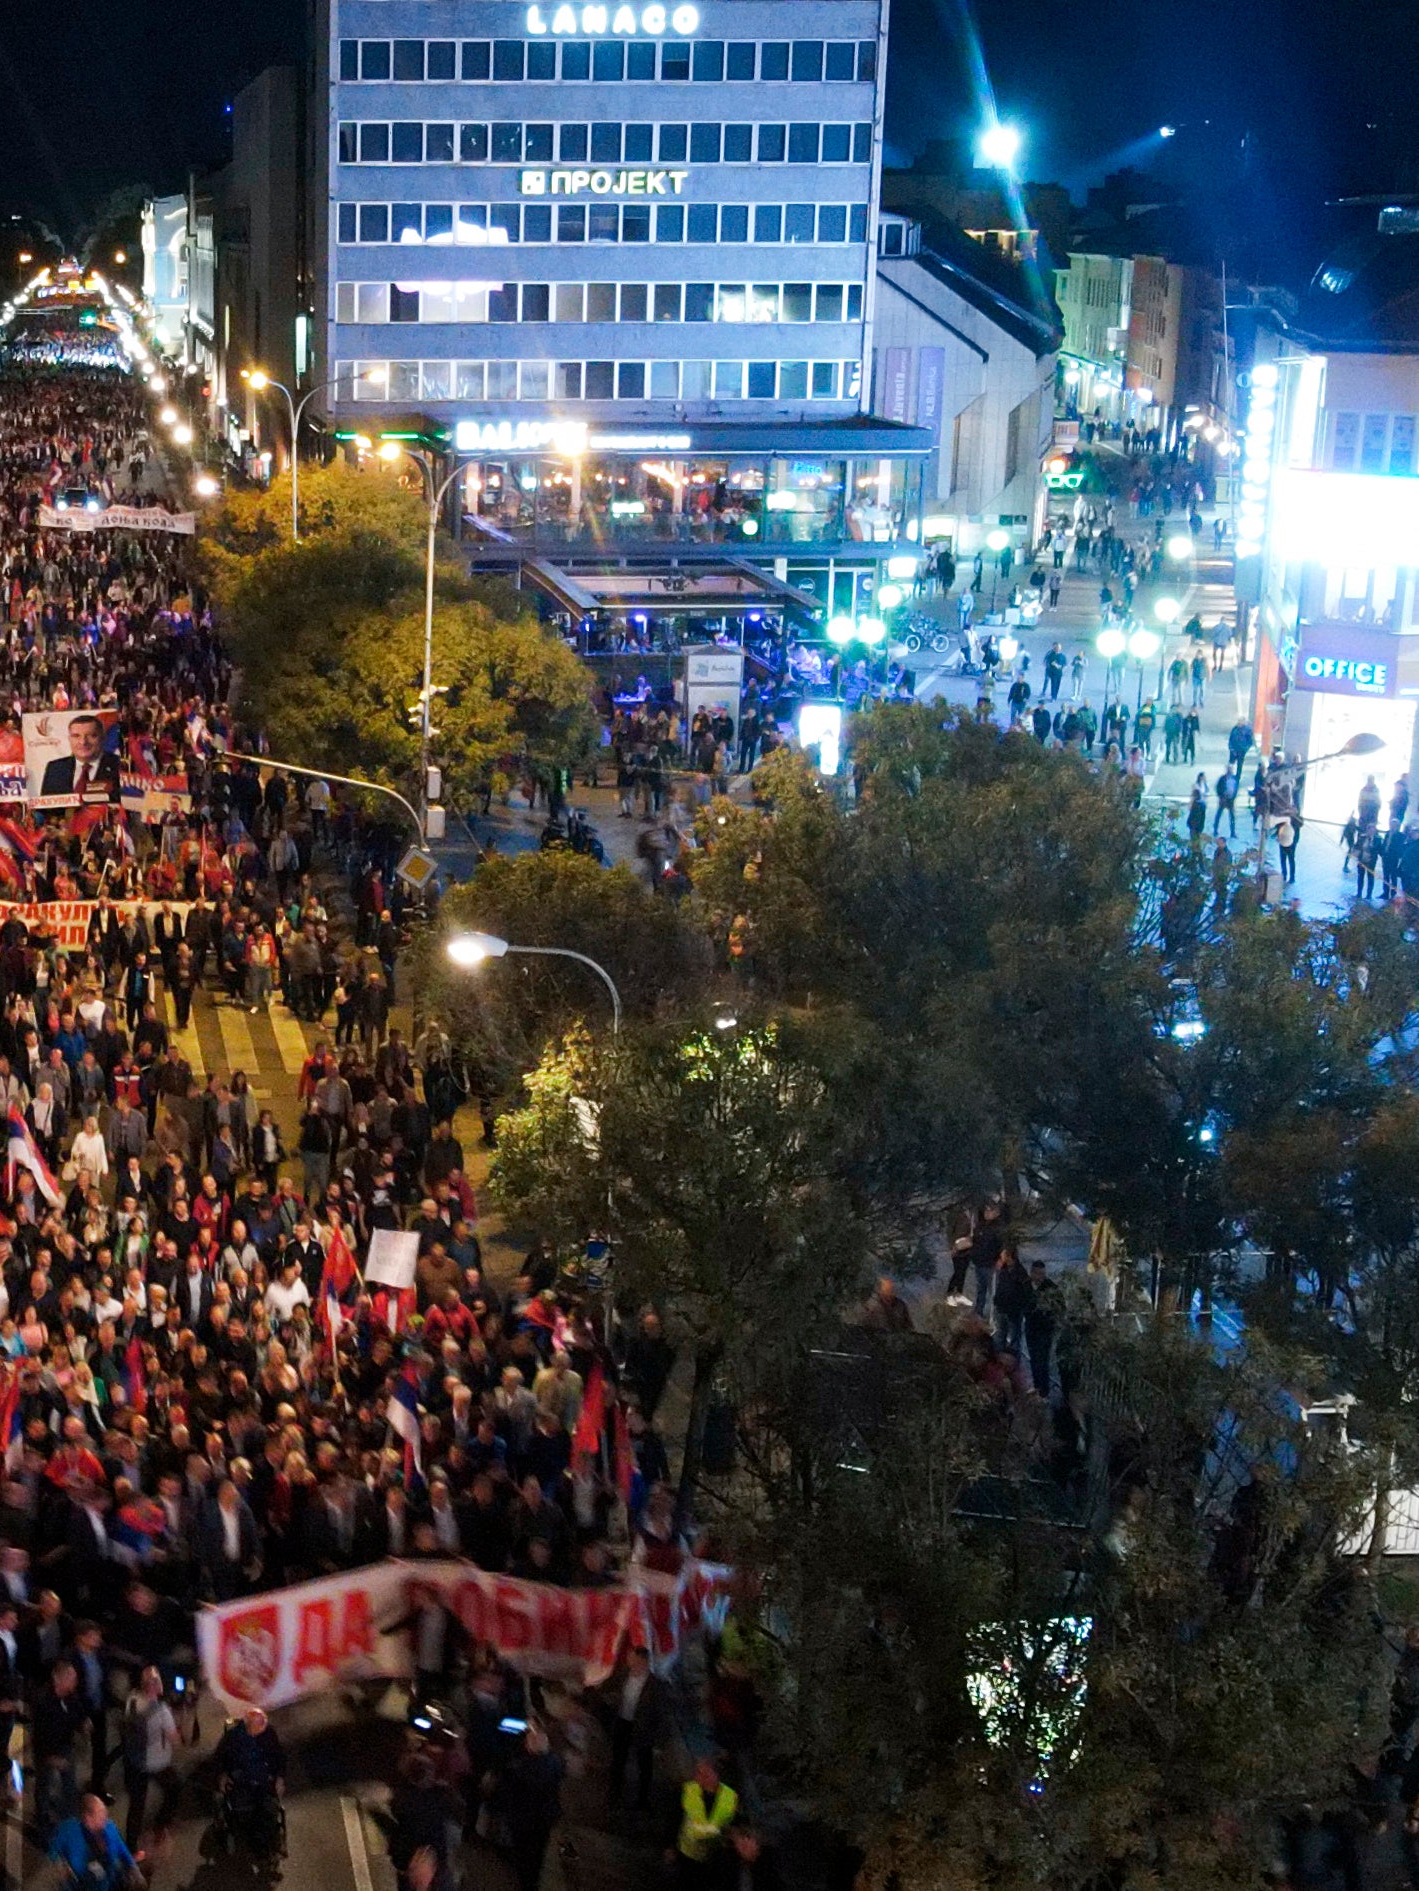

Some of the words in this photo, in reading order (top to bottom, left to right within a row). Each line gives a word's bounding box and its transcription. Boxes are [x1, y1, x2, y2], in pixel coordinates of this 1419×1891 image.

[526, 4, 700, 35] LANACO
[551, 170, 689, 195] ПРОЈЕКТ
[1305, 656, 1386, 684] OFFICE
